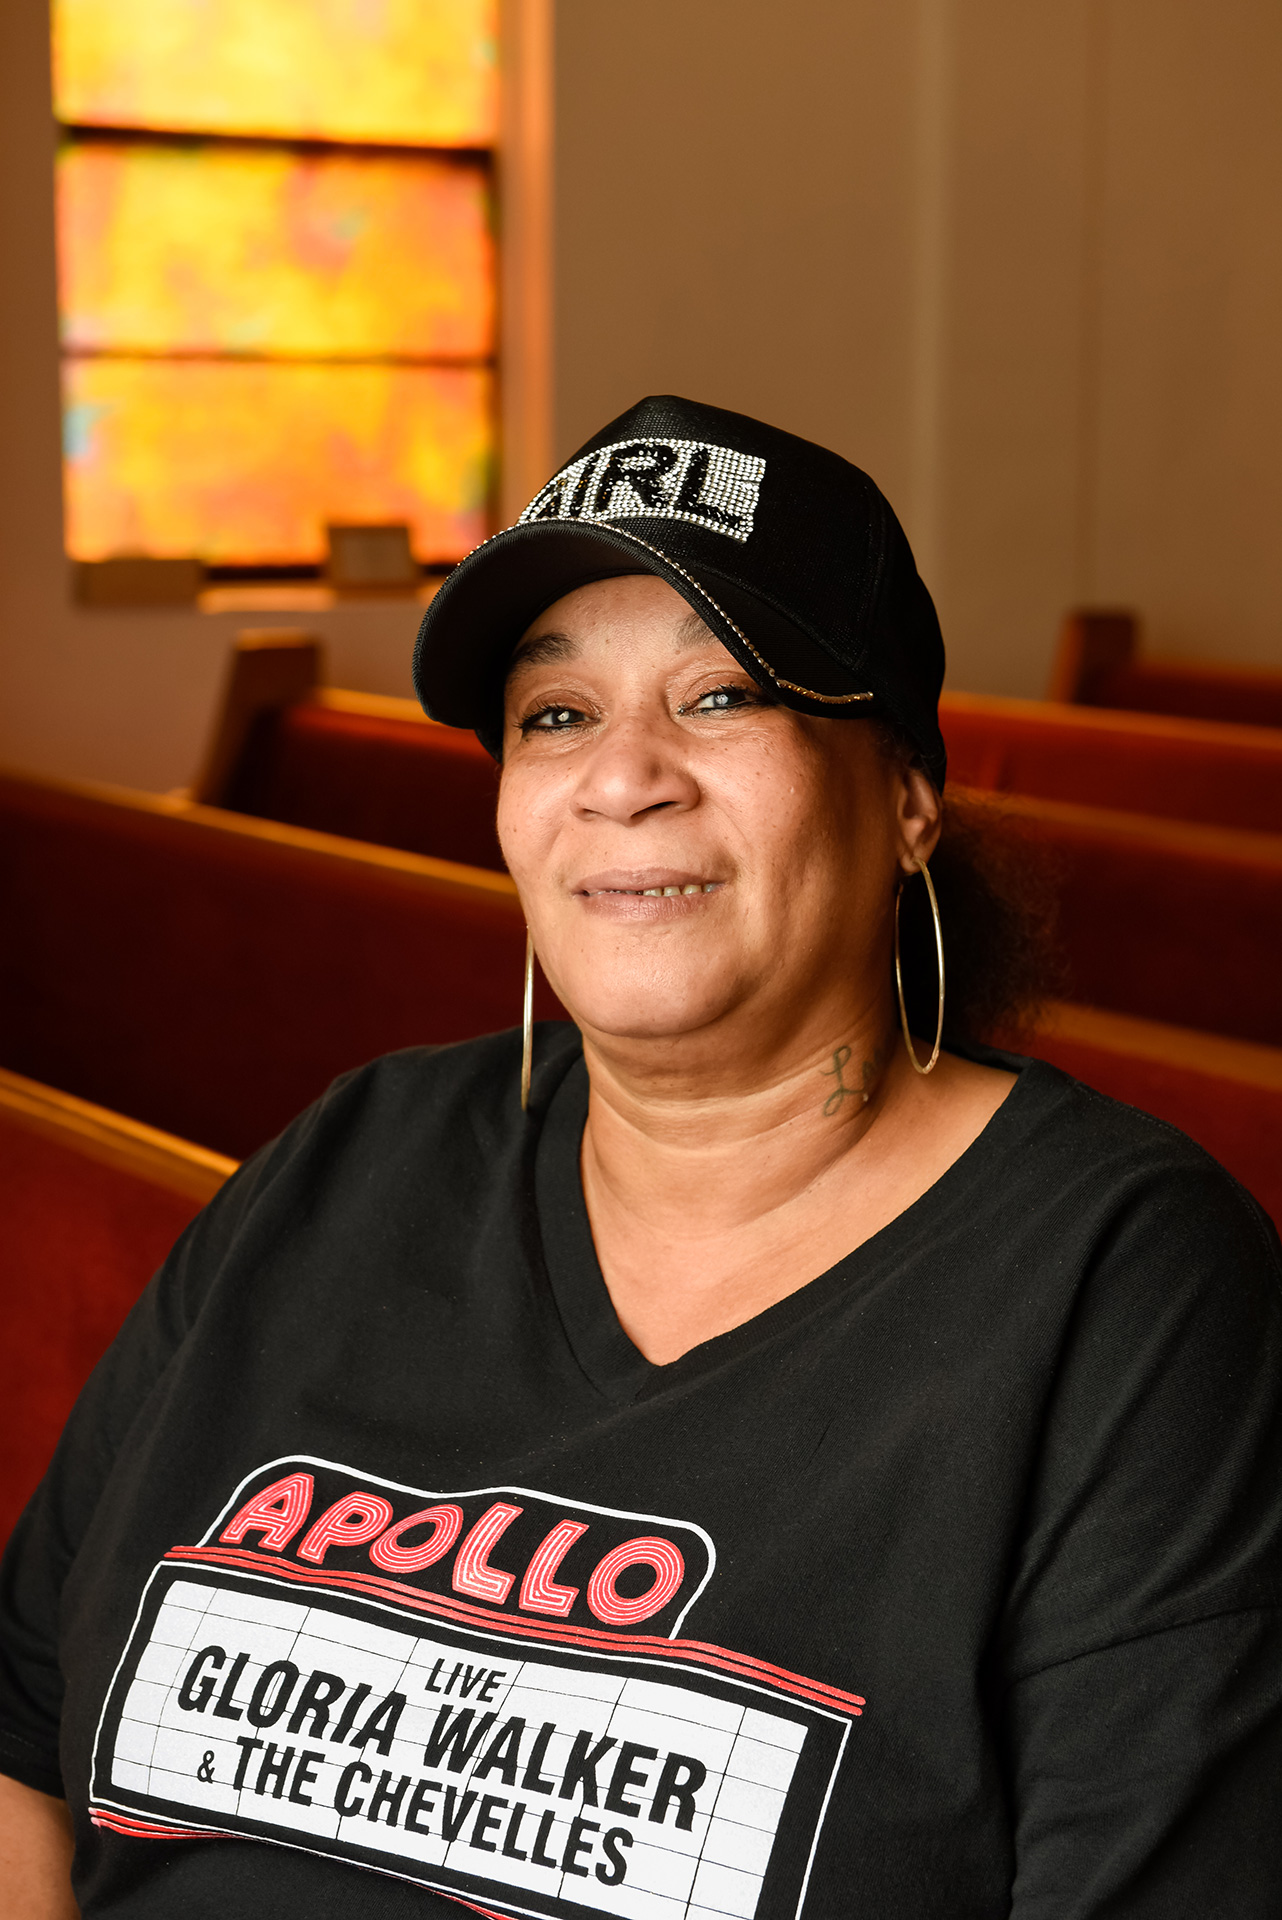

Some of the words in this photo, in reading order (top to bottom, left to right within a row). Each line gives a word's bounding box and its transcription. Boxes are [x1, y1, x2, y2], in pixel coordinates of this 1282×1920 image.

[220, 1472, 685, 1625] APOLLO
[177, 1645, 409, 1756] GLORIA
[423, 1703, 707, 1832] WALKER
[425, 1658, 507, 1703] LIVE
[196, 1749, 216, 1784] &
[234, 1735, 326, 1806] THE
[333, 1761, 634, 1886] CHEVELLES
